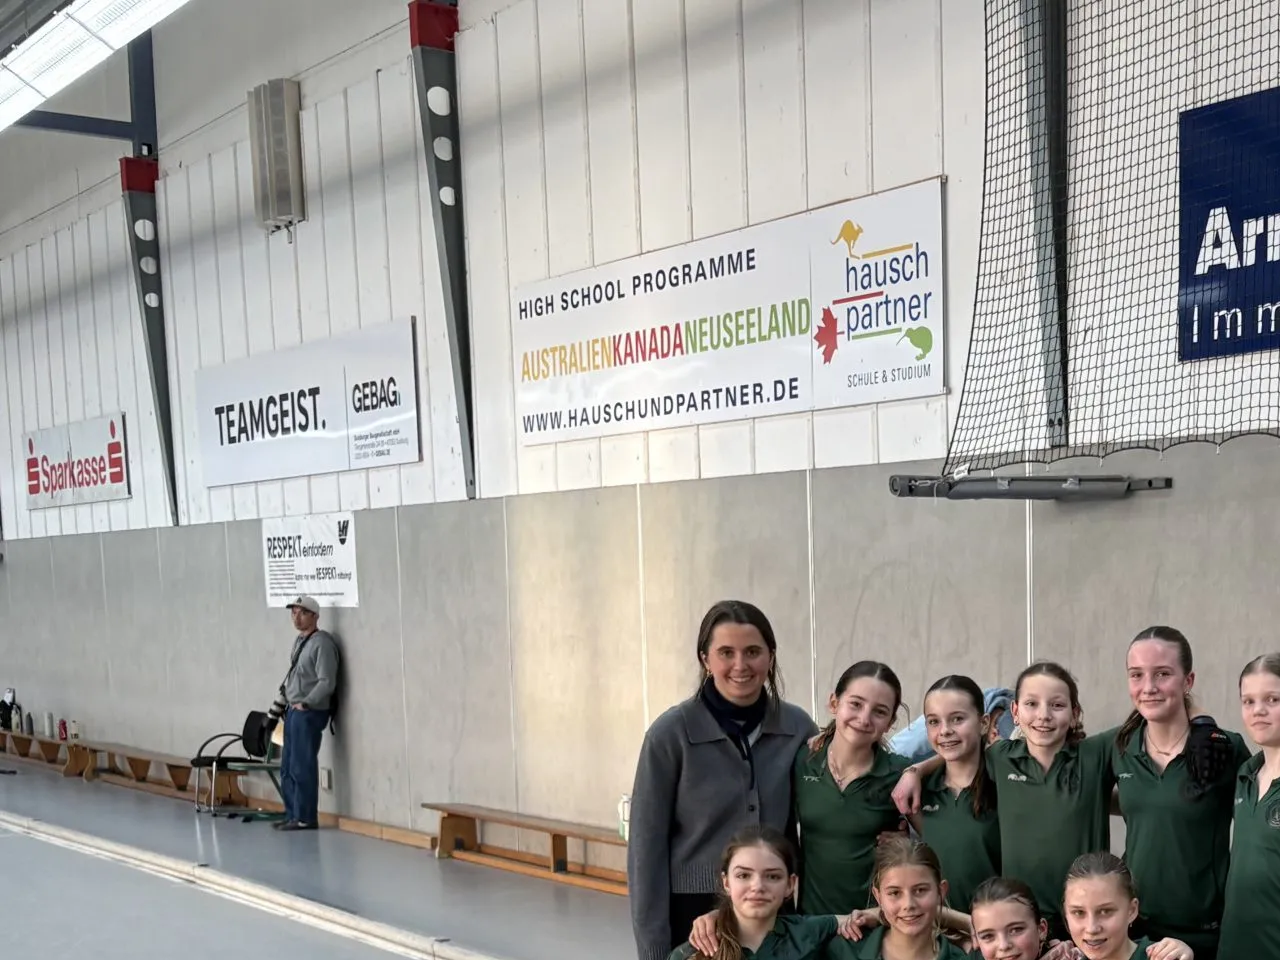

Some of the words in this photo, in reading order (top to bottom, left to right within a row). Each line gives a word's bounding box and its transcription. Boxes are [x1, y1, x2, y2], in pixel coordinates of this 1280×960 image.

[519, 294, 555, 320] HIGH
[561, 279, 626, 312] SCHOOL
[632, 248, 757, 296] PROGRAMME
[846, 241, 929, 293] hausch
[846, 291, 933, 341] partner
[847, 370, 879, 388] SCHULE
[881, 369, 889, 383] &
[891, 363, 931, 382] STUDIUM
[214, 386, 326, 446] TEAMGEIST.
[522, 376, 800, 434] WWW.HAUSCHUNDPARTNER.DE
[41, 454, 107, 499] Sparkasse
[266, 534, 302, 558] RESPEKT
